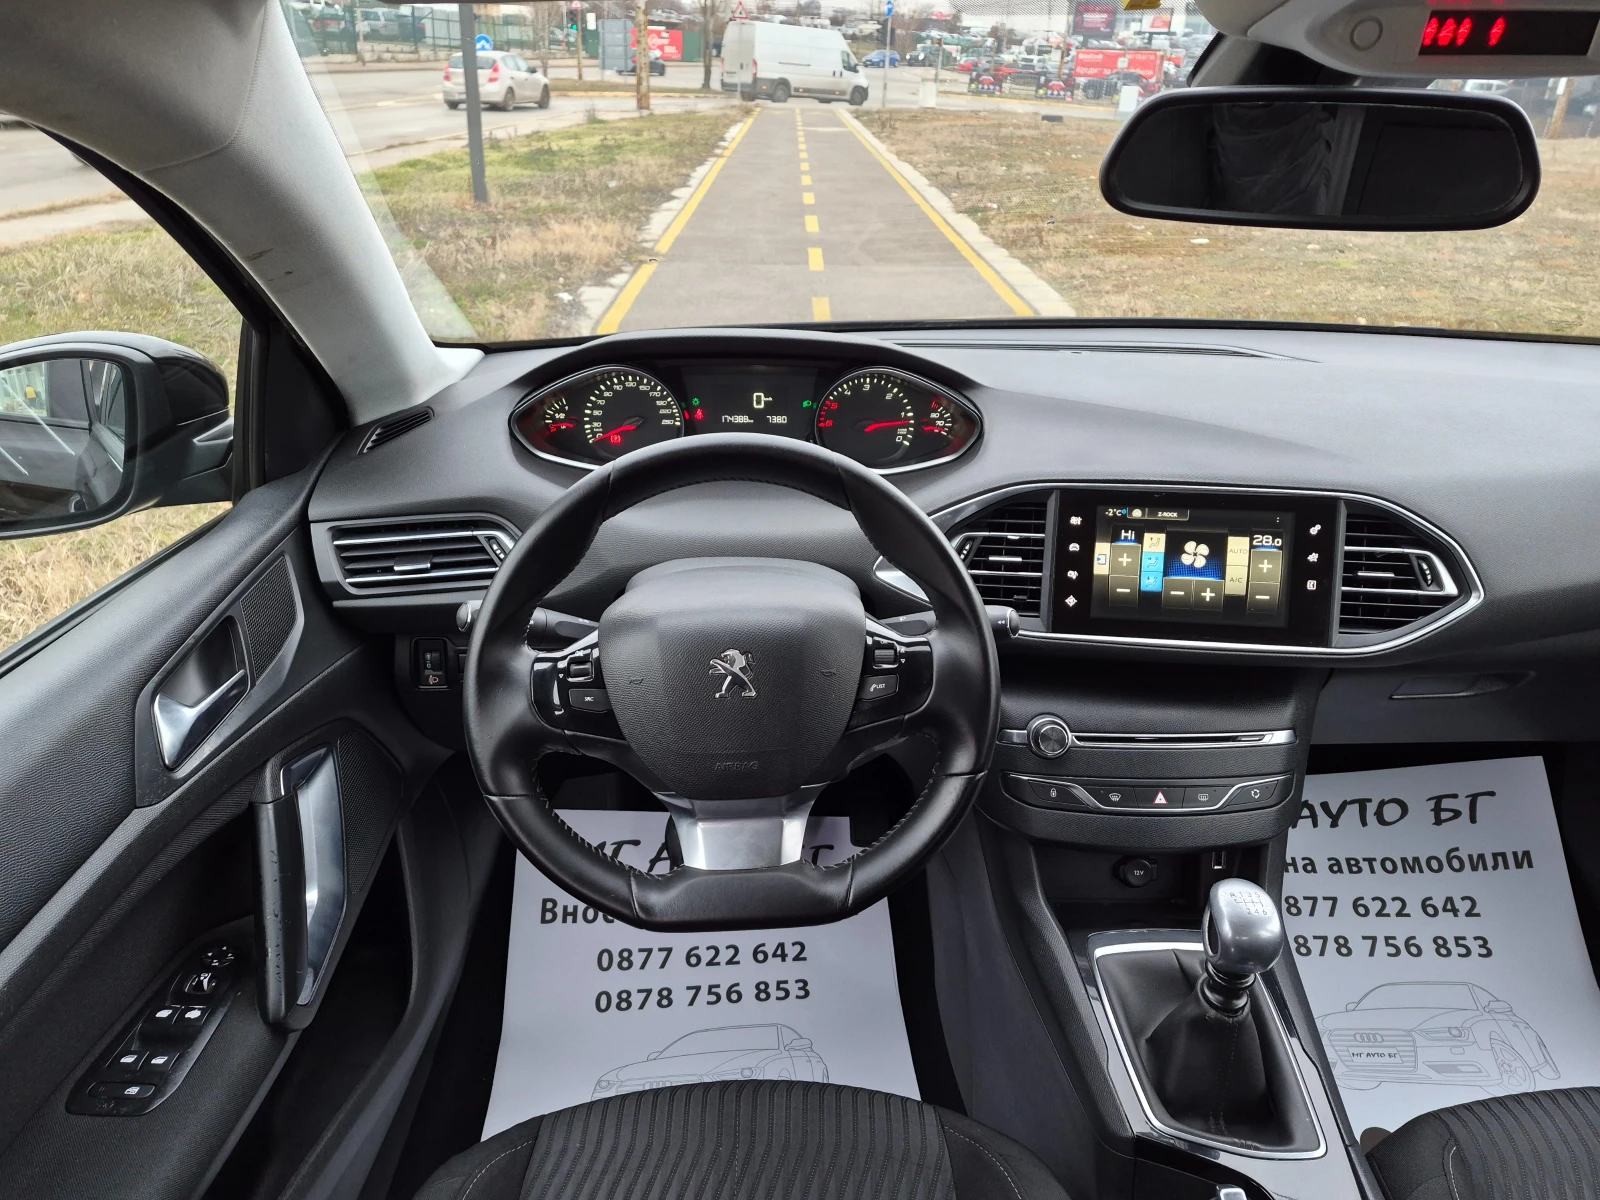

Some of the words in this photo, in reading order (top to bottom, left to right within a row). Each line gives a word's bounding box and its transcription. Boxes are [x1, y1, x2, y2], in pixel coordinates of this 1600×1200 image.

[753, 392, 765, 409] 0
[1121, 529, 1136, 541] Hi
[1252, 534, 1283, 547] 28.0
[1291, 797, 1409, 829] АУТО
[1426, 790, 1497, 827] БГ
[1285, 856, 1318, 874] на
[1327, 846, 1534, 875] автомобили
[1284, 895, 1338, 918] 877
[1351, 895, 1412, 918] 622
[1420, 895, 1482, 918] 642
[596, 946, 674, 973] 0877
[684, 944, 741, 969] 622
[751, 940, 808, 965] 642
[1293, 934, 1353, 958] 878
[1361, 935, 1423, 958] 756
[1432, 935, 1493, 959] 853
[594, 986, 674, 1014] 0878
[685, 982, 743, 1007] 756
[753, 978, 811, 1003] 853
